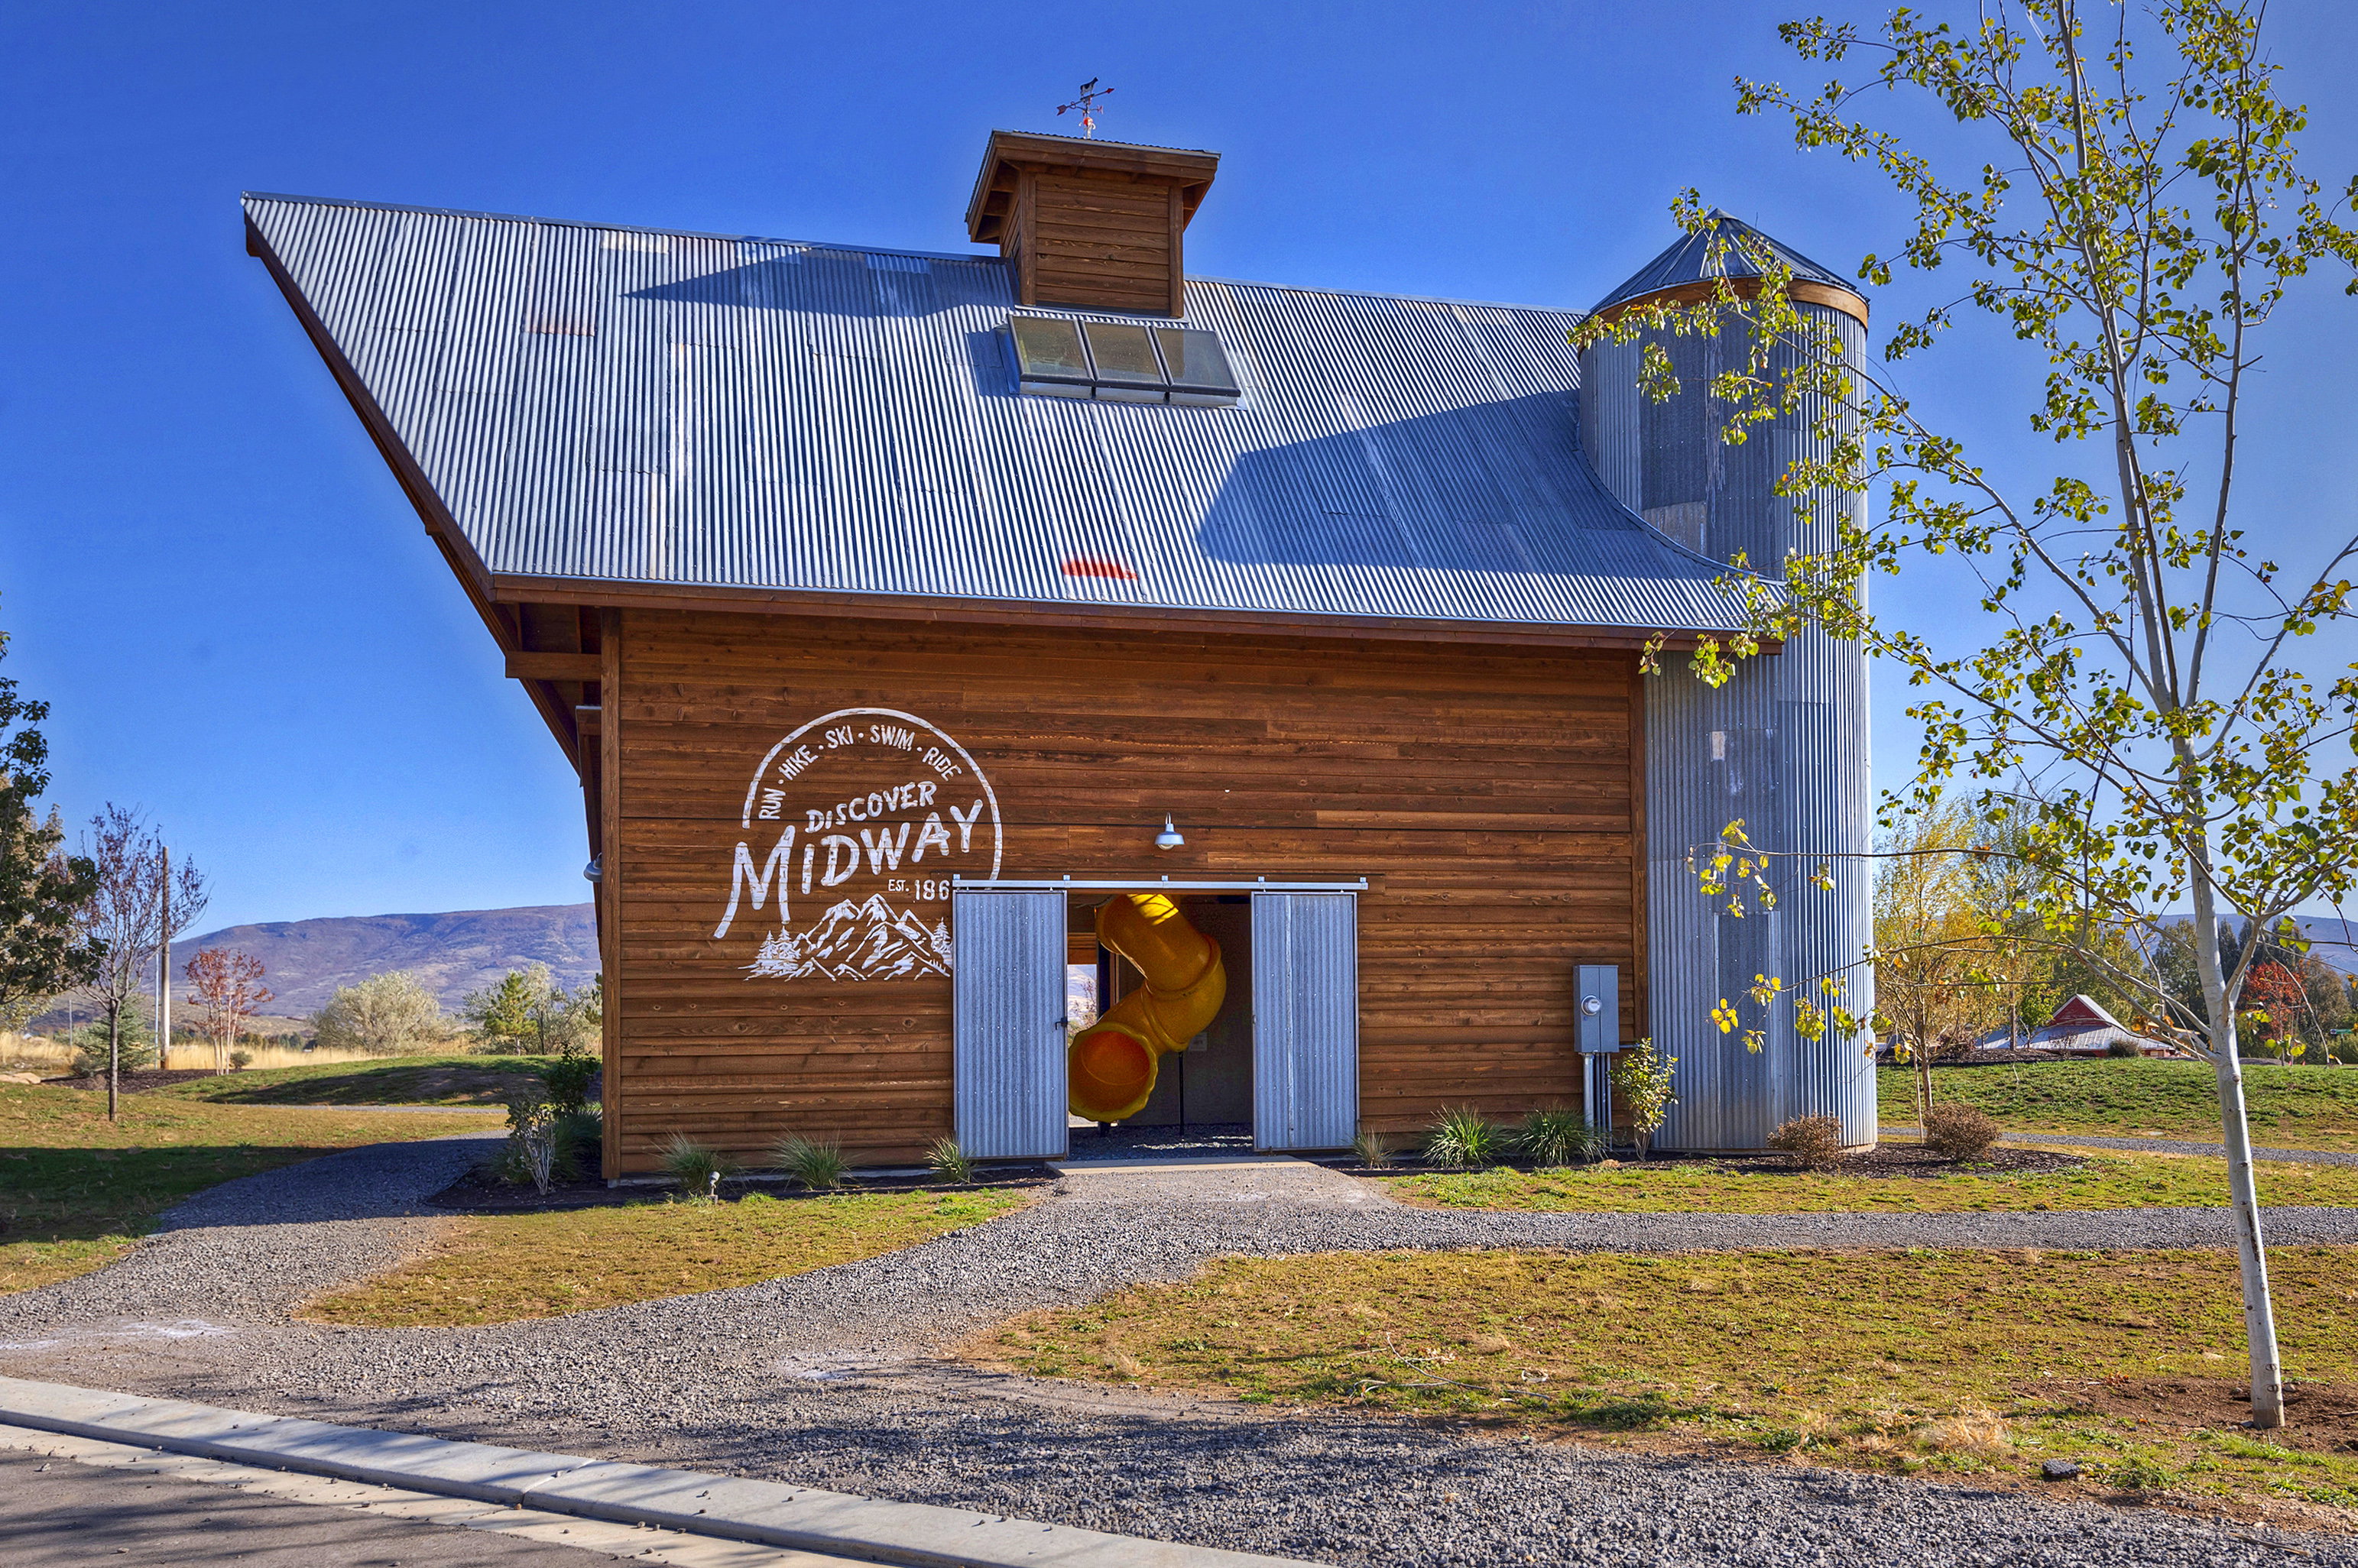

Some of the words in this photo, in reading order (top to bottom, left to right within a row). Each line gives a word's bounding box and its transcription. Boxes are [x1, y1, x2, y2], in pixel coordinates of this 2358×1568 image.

[758, 787, 787, 820] RUN
[778, 744, 819, 781] HIKE
[825, 724, 854, 749] SKI
[870, 724, 916, 752] SWIM
[922, 747, 962, 782] RIDE
[806, 780, 937, 833] DISCOVER
[712, 799, 984, 939] MIDWAY
[887, 878, 910, 893] EST.
[914, 879, 950, 901] 186
